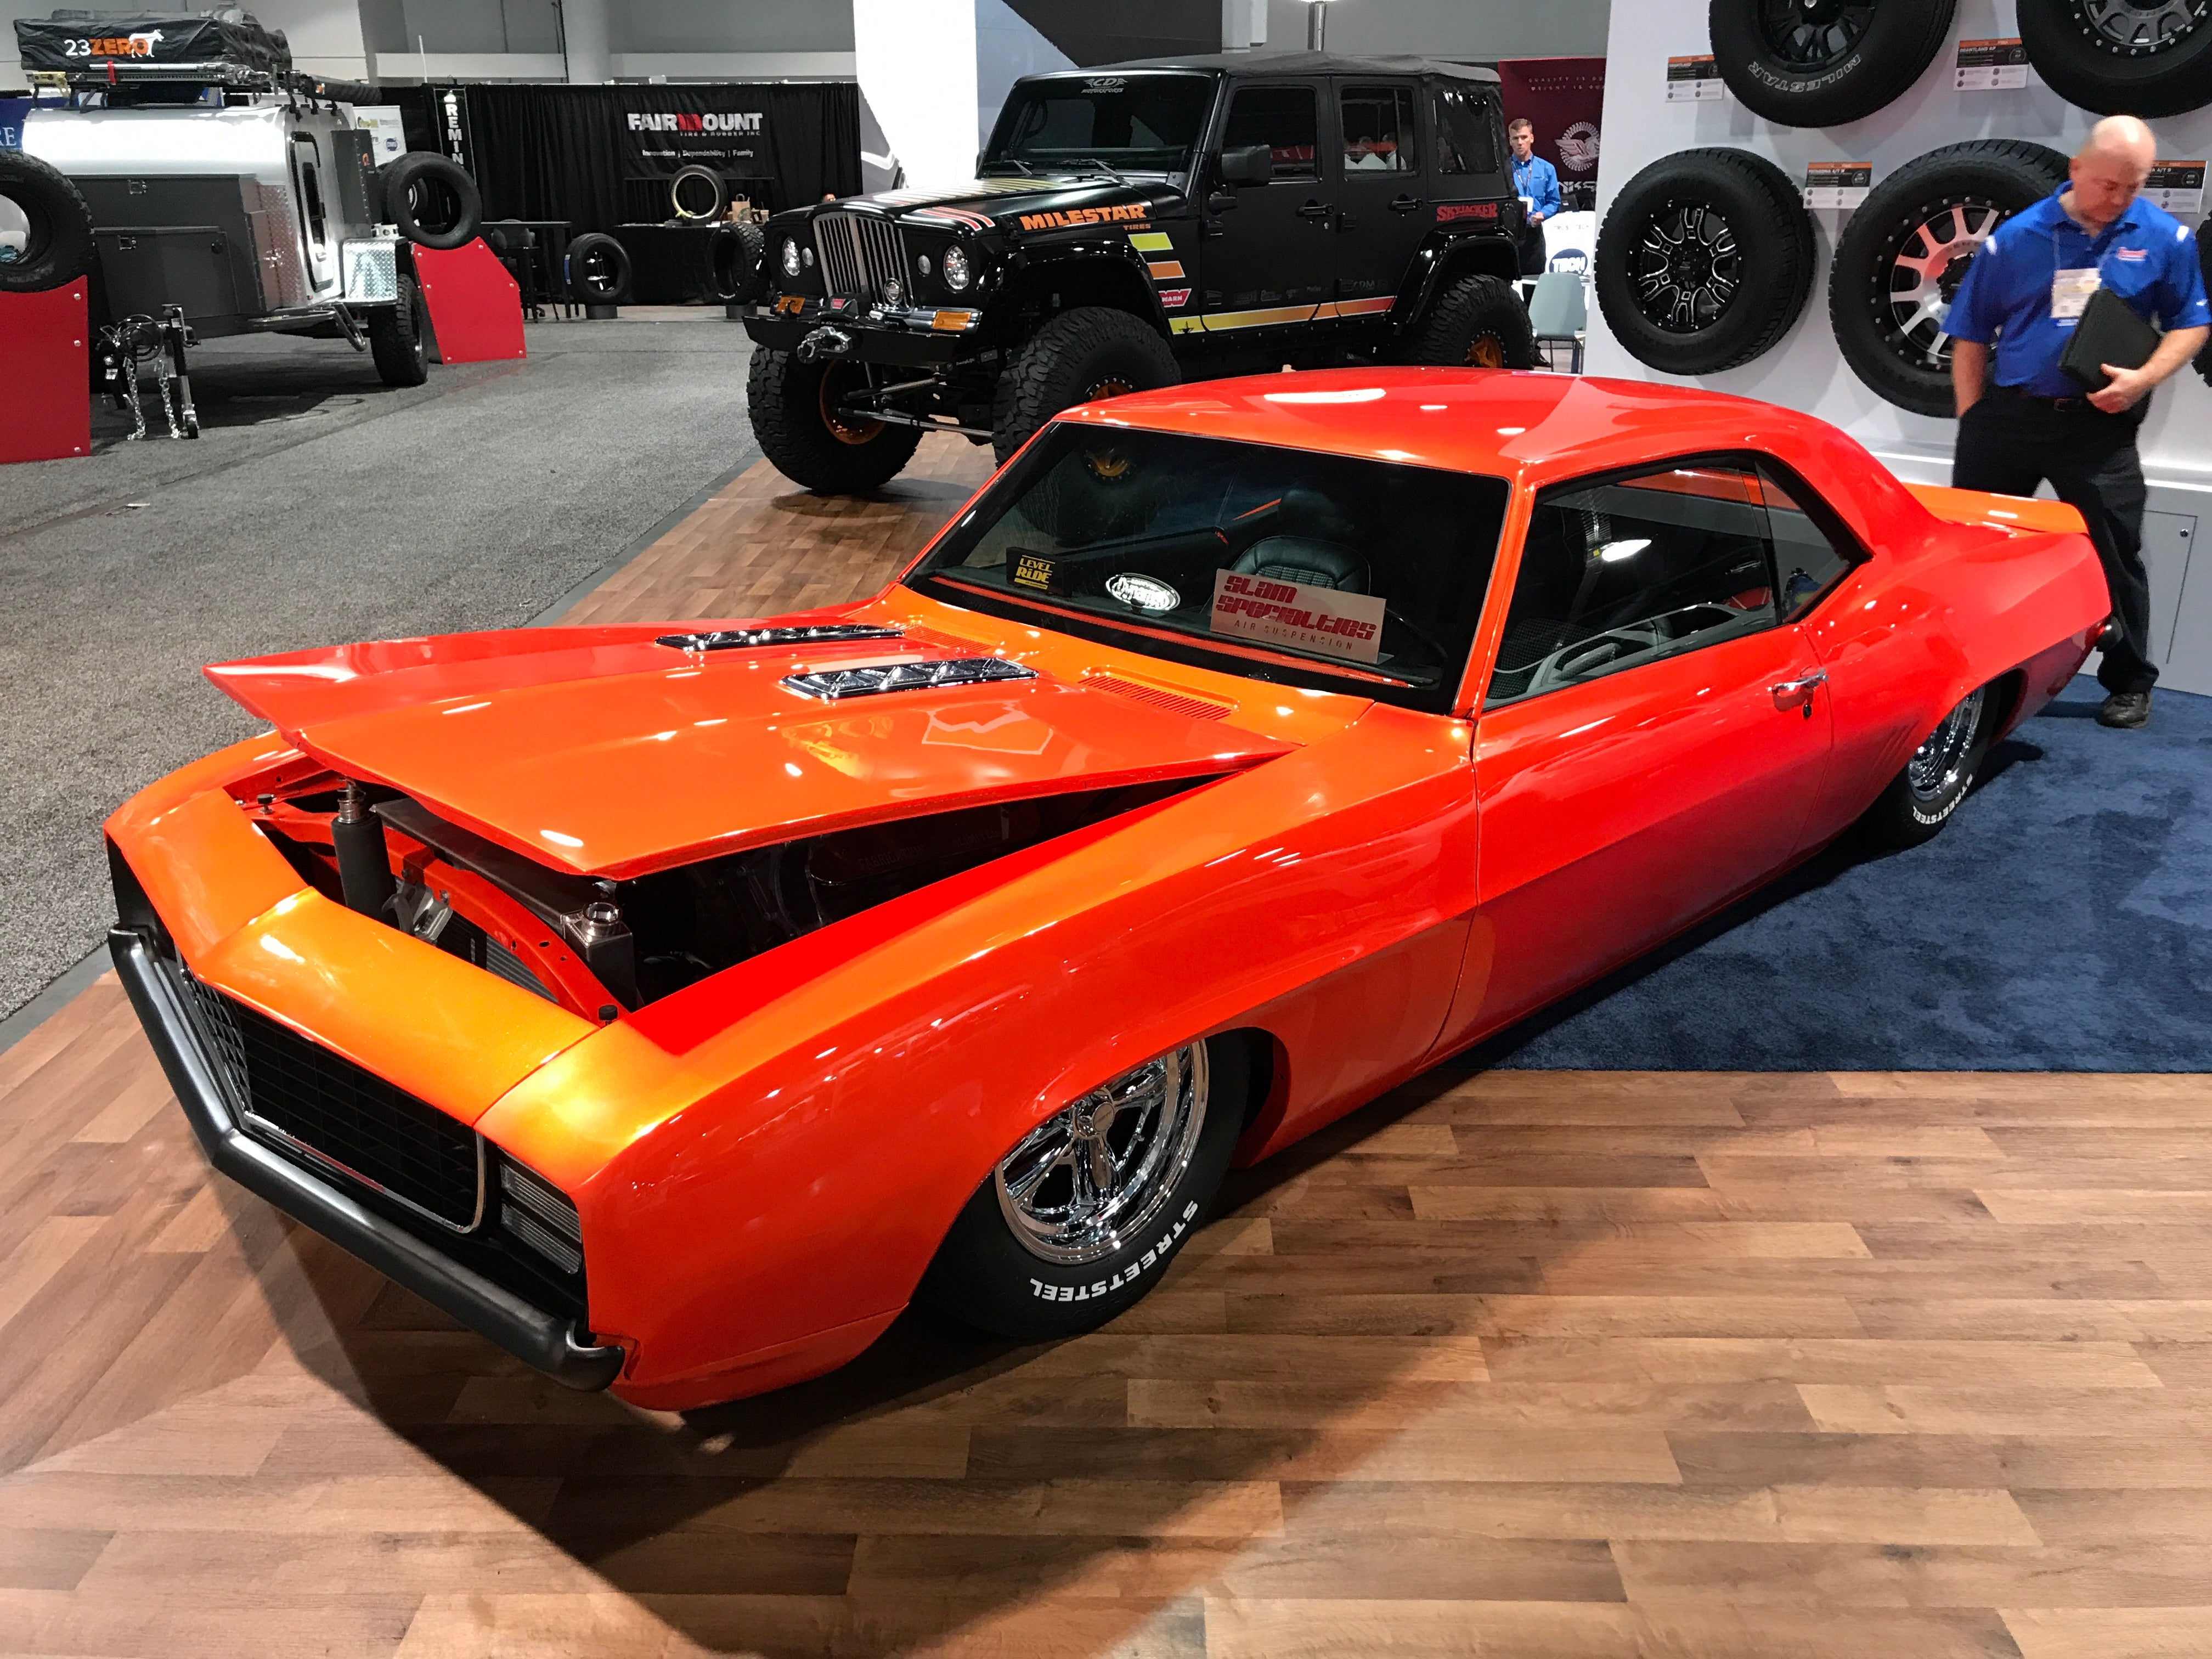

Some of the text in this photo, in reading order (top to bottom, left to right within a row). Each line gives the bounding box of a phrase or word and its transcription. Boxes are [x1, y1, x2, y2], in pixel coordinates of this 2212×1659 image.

[64, 38, 149, 56] 23ZERO
[1748, 54, 1861, 93] MILESTAR
[445, 104, 465, 170] REMIN
[1019, 204, 1147, 231] MILESTAR
[1436, 202, 1498, 222] SKYJACKER
[1123, 223, 1152, 231] TIRES
[1552, 256, 1587, 273] TECH
[1161, 295, 1183, 303] WARN
[1019, 558, 1053, 573] LEVEL
[1234, 619, 1353, 651] AIR SUSPENSION
[1913, 773, 1973, 825] STREETSTEEL
[1030, 1200, 1199, 1302] STREETSTEEL
